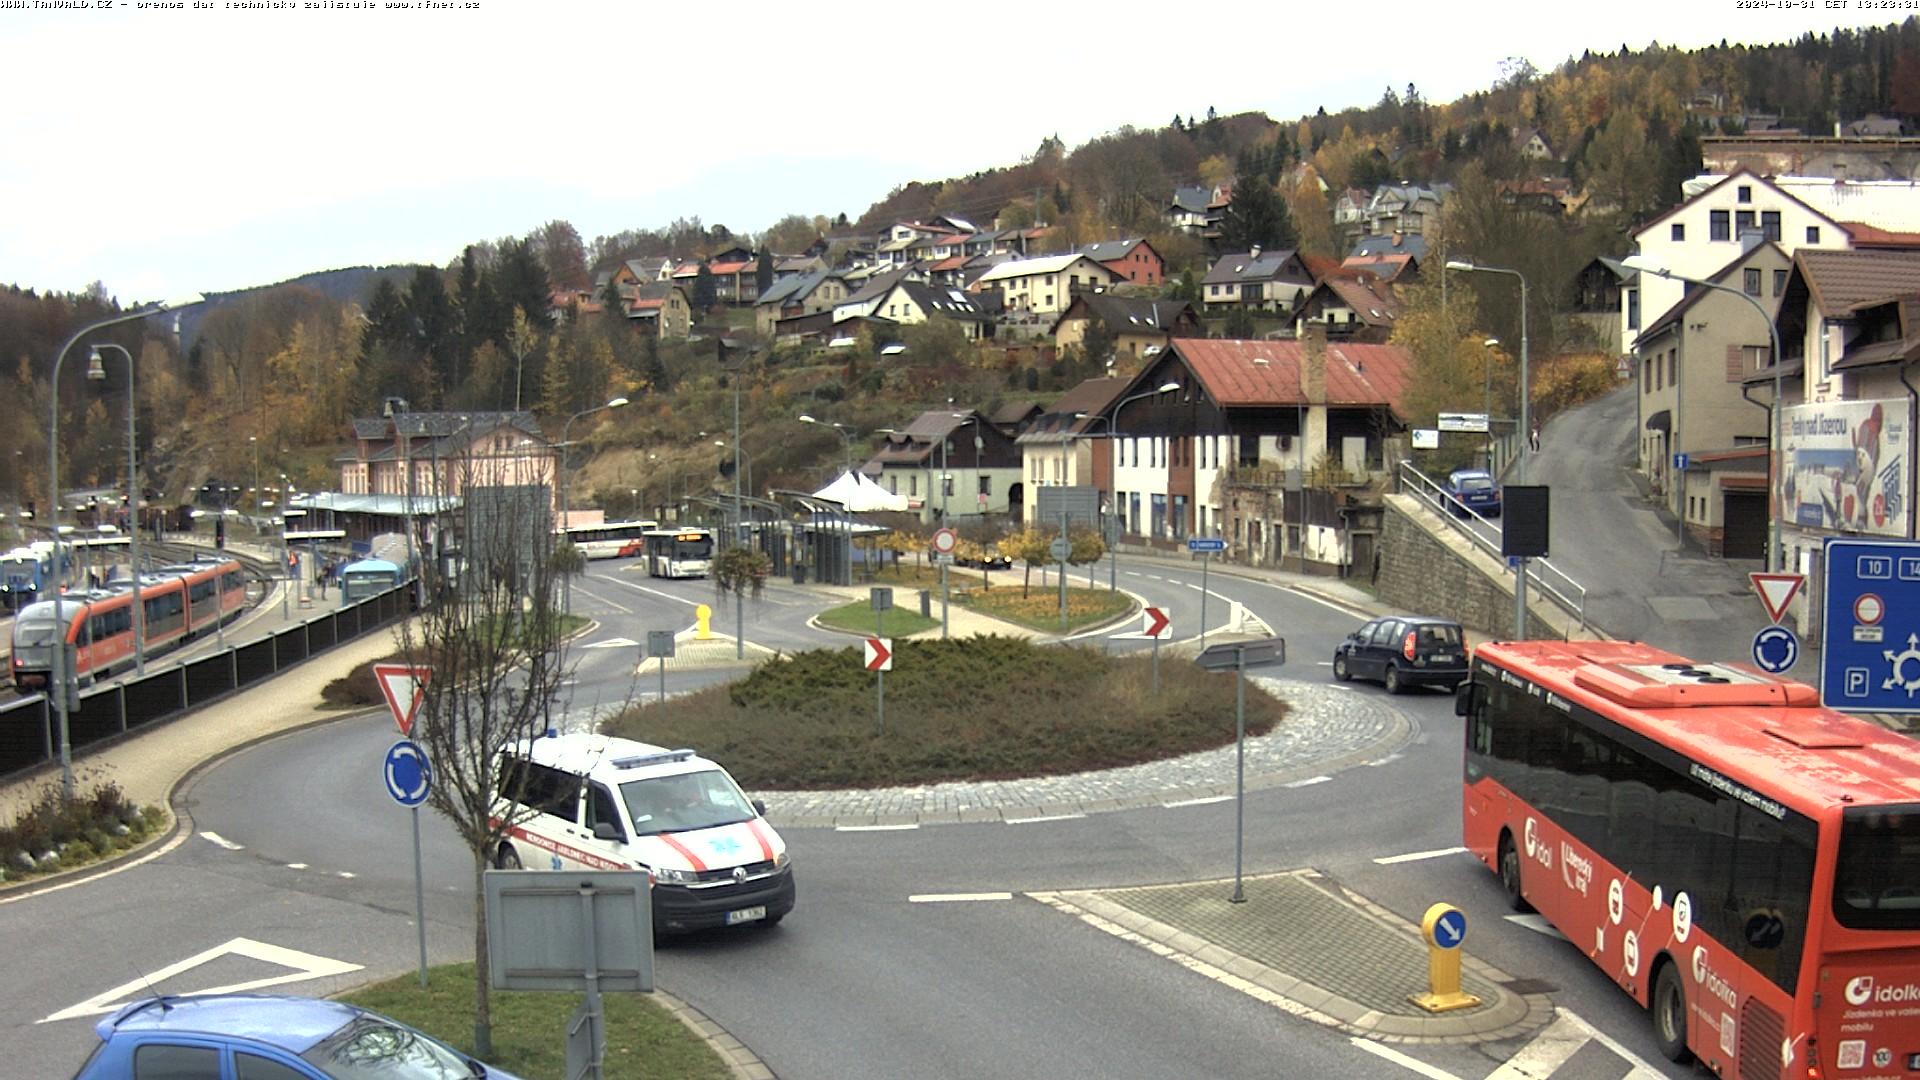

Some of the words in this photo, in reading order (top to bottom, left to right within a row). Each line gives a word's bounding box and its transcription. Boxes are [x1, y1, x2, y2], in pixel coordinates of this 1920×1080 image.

[1868, 560, 1882, 575] 10
[1850, 673, 1864, 692] P
[1536, 837, 1552, 869] idol
[1706, 966, 1737, 1009] idolka
[1885, 1009, 1897, 1017] ve
[1840, 1023, 1874, 1032] mobilu
